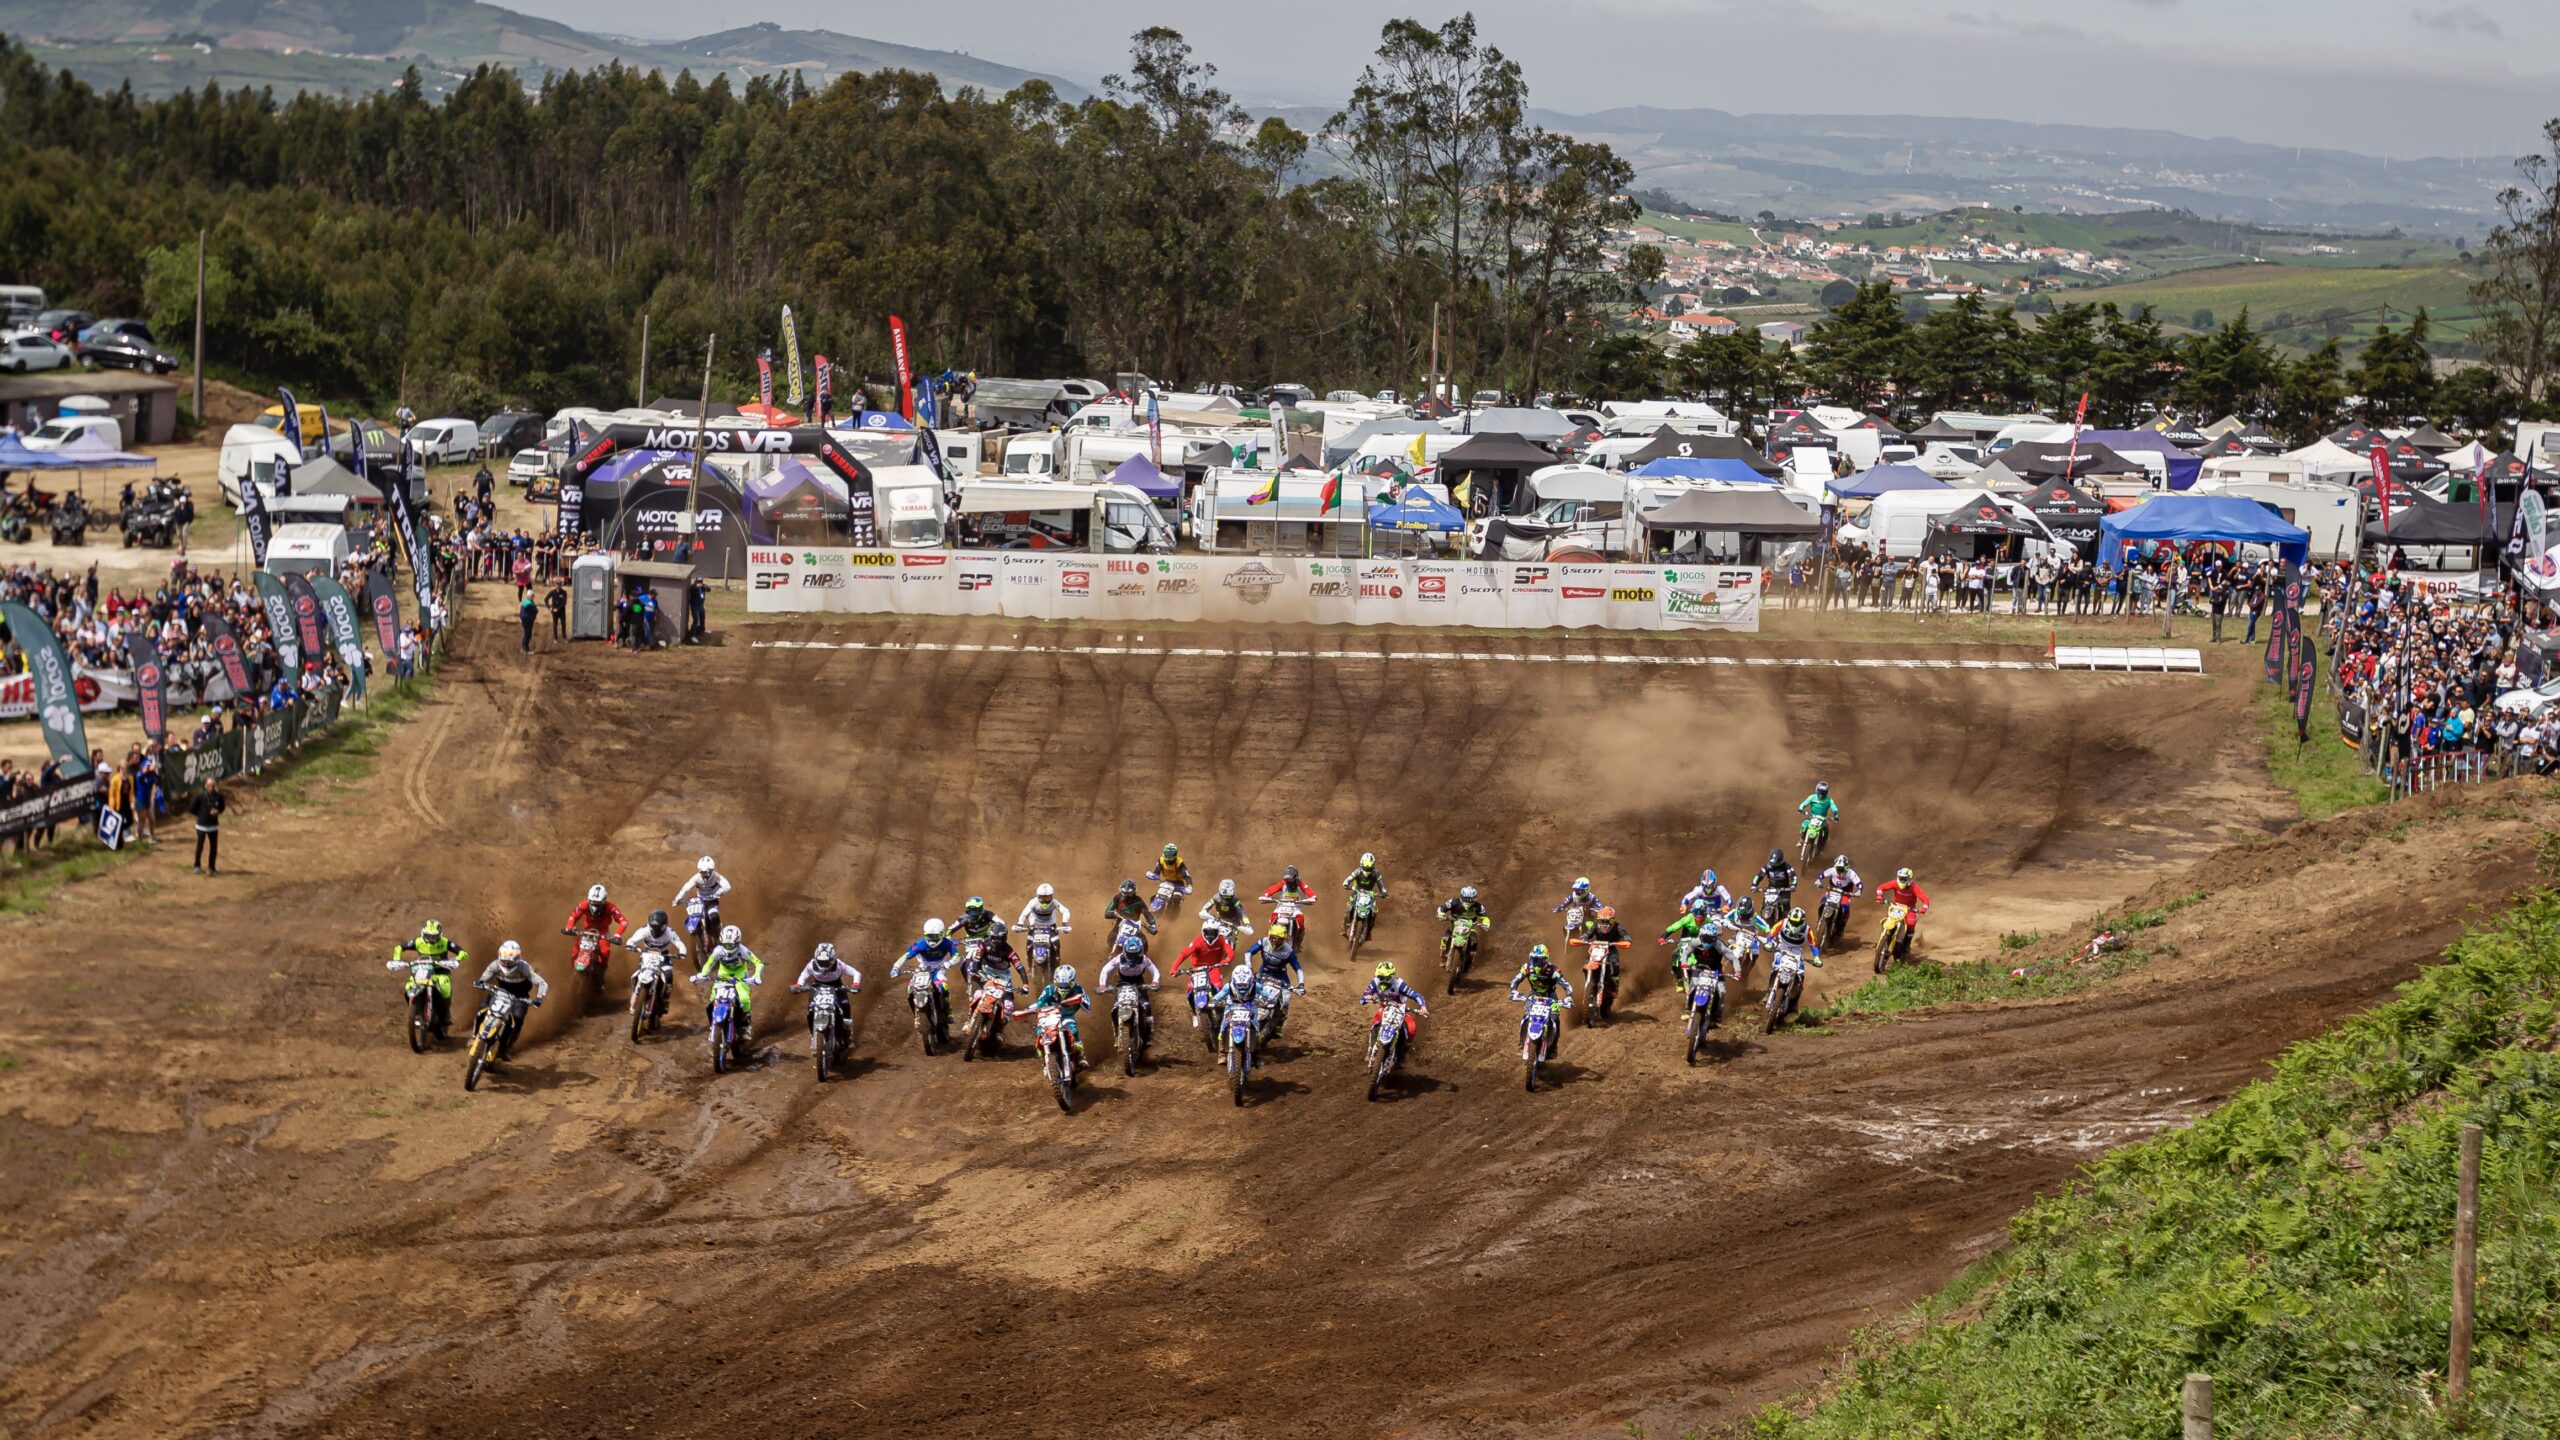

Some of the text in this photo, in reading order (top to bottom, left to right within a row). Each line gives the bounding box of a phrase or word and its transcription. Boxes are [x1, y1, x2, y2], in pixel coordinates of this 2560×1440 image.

[644, 428, 793, 452] MOTOS VR
[929, 450, 939, 465] VR
[828, 450, 859, 479] YAMAHA
[274, 459, 287, 489] VR
[662, 468, 693, 480] VR
[560, 490, 583, 503] VR
[851, 496, 873, 509] VR
[900, 504, 928, 512] YAMAHA
[240, 479, 266, 562] MOTOS VR
[637, 509, 723, 523] MOTO VR
[2051, 528, 2098, 538] 24MX
[752, 552, 778, 564] HELL
[819, 554, 845, 564] JOGOS
[853, 552, 894, 566] moto
[1107, 560, 1134, 572] HELL
[1172, 562, 1198, 571] JOGOS
[1326, 564, 1352, 574] JOGOS
[755, 572, 790, 590] SP
[802, 573, 833, 587] FMP
[958, 573, 993, 590] SP
[1223, 573, 1286, 588] MOTOCROSS
[1514, 567, 1549, 584] SP
[1680, 572, 1706, 581] JOGOS
[1718, 571, 1753, 589] SP
[1156, 579, 1187, 592] FMP
[1309, 582, 1340, 595] FMP
[1360, 584, 1387, 596] HELL
[1612, 588, 1654, 601] moto
[1670, 590, 1702, 600] OESTE
[1680, 601, 1719, 613] CARNES
[915, 975, 930, 987] 91
[1192, 972, 1207, 987] 16
[814, 993, 835, 1005] 225
[1530, 1004, 1550, 1016] 585
